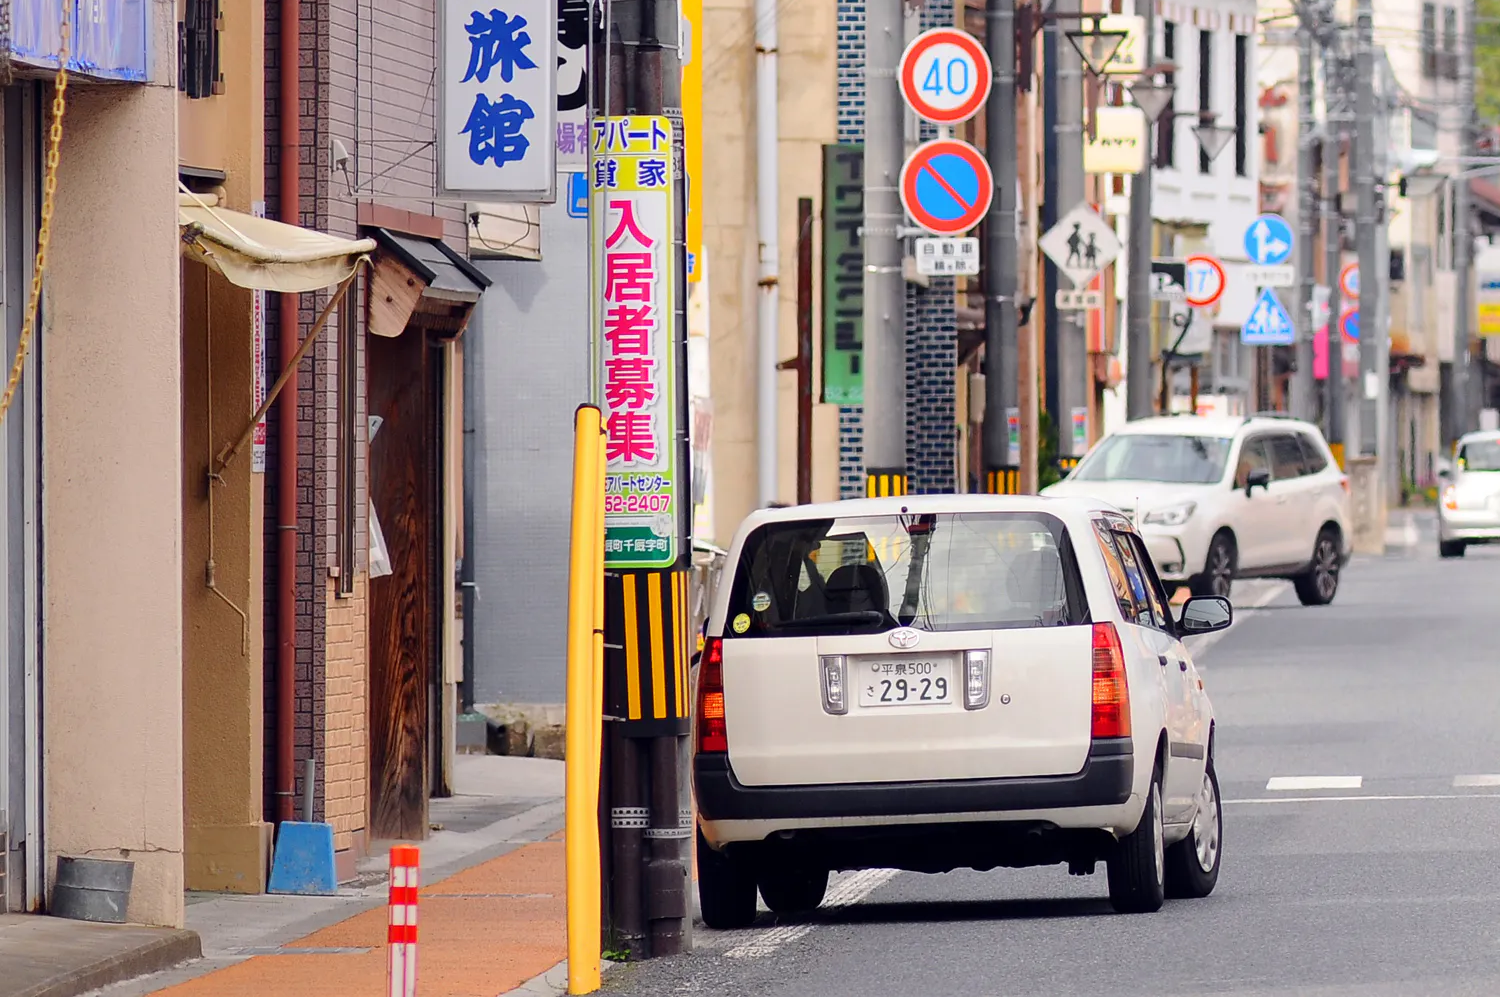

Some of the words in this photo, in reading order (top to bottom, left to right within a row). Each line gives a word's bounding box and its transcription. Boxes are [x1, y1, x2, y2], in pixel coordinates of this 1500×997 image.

[922, 57, 969, 96] 40
[593, 118, 667, 150] アパート
[594, 159, 667, 188] 貸家
[924, 242, 973, 254] 自動車
[604, 200, 655, 462] 入居者募集
[605, 475, 670, 492] アパートセンター
[605, 495, 670, 512] 52-2407
[866, 685, 876, 698] さ
[881, 678, 947, 701] 29-29
